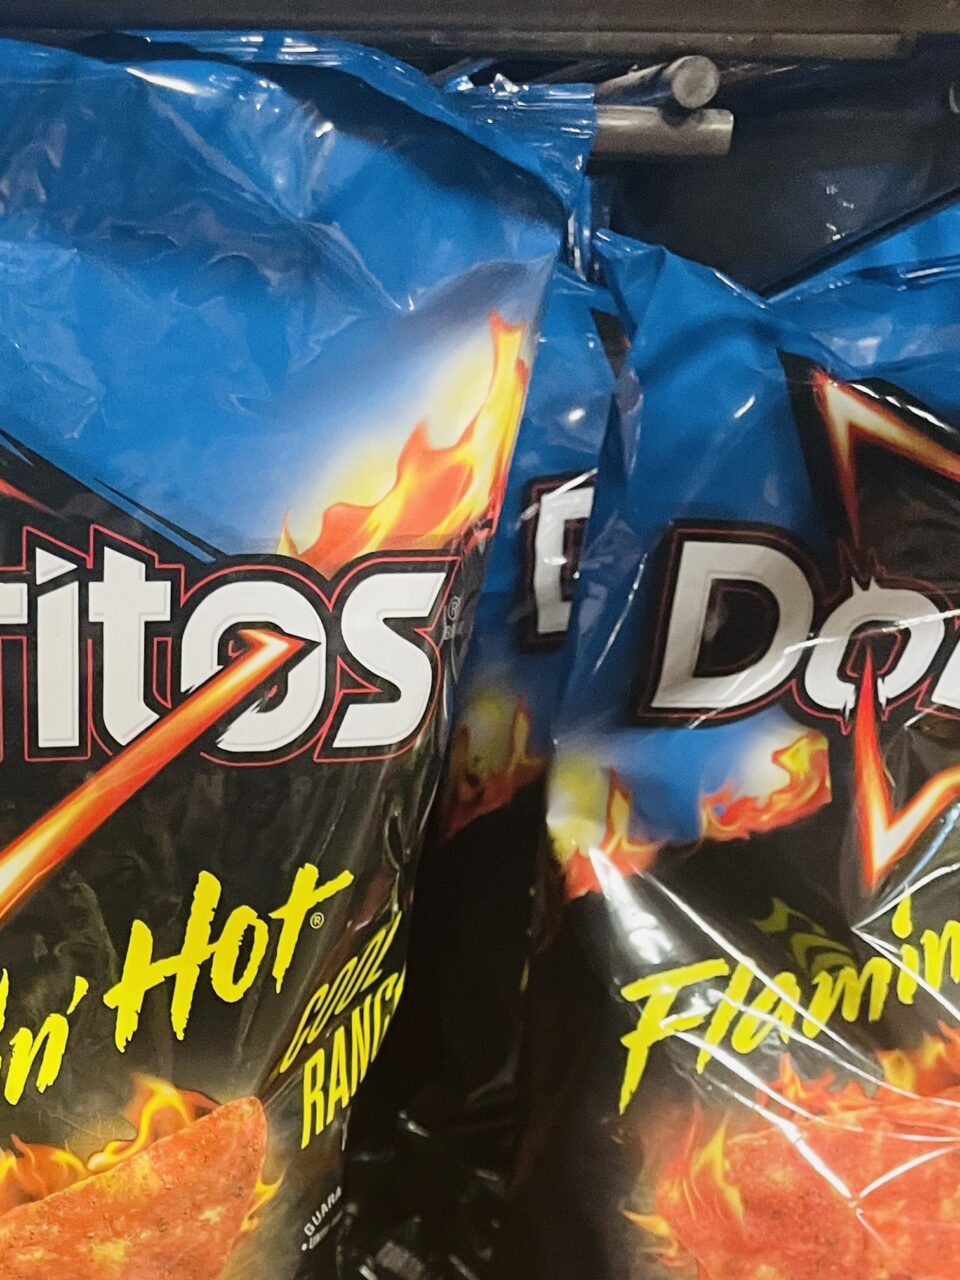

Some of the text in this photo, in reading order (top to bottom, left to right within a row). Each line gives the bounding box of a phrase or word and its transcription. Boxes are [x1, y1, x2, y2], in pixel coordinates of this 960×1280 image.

[102, 863, 355, 1051] Hot
[278, 910, 402, 1074] COOL
[301, 960, 407, 1149] RANC
